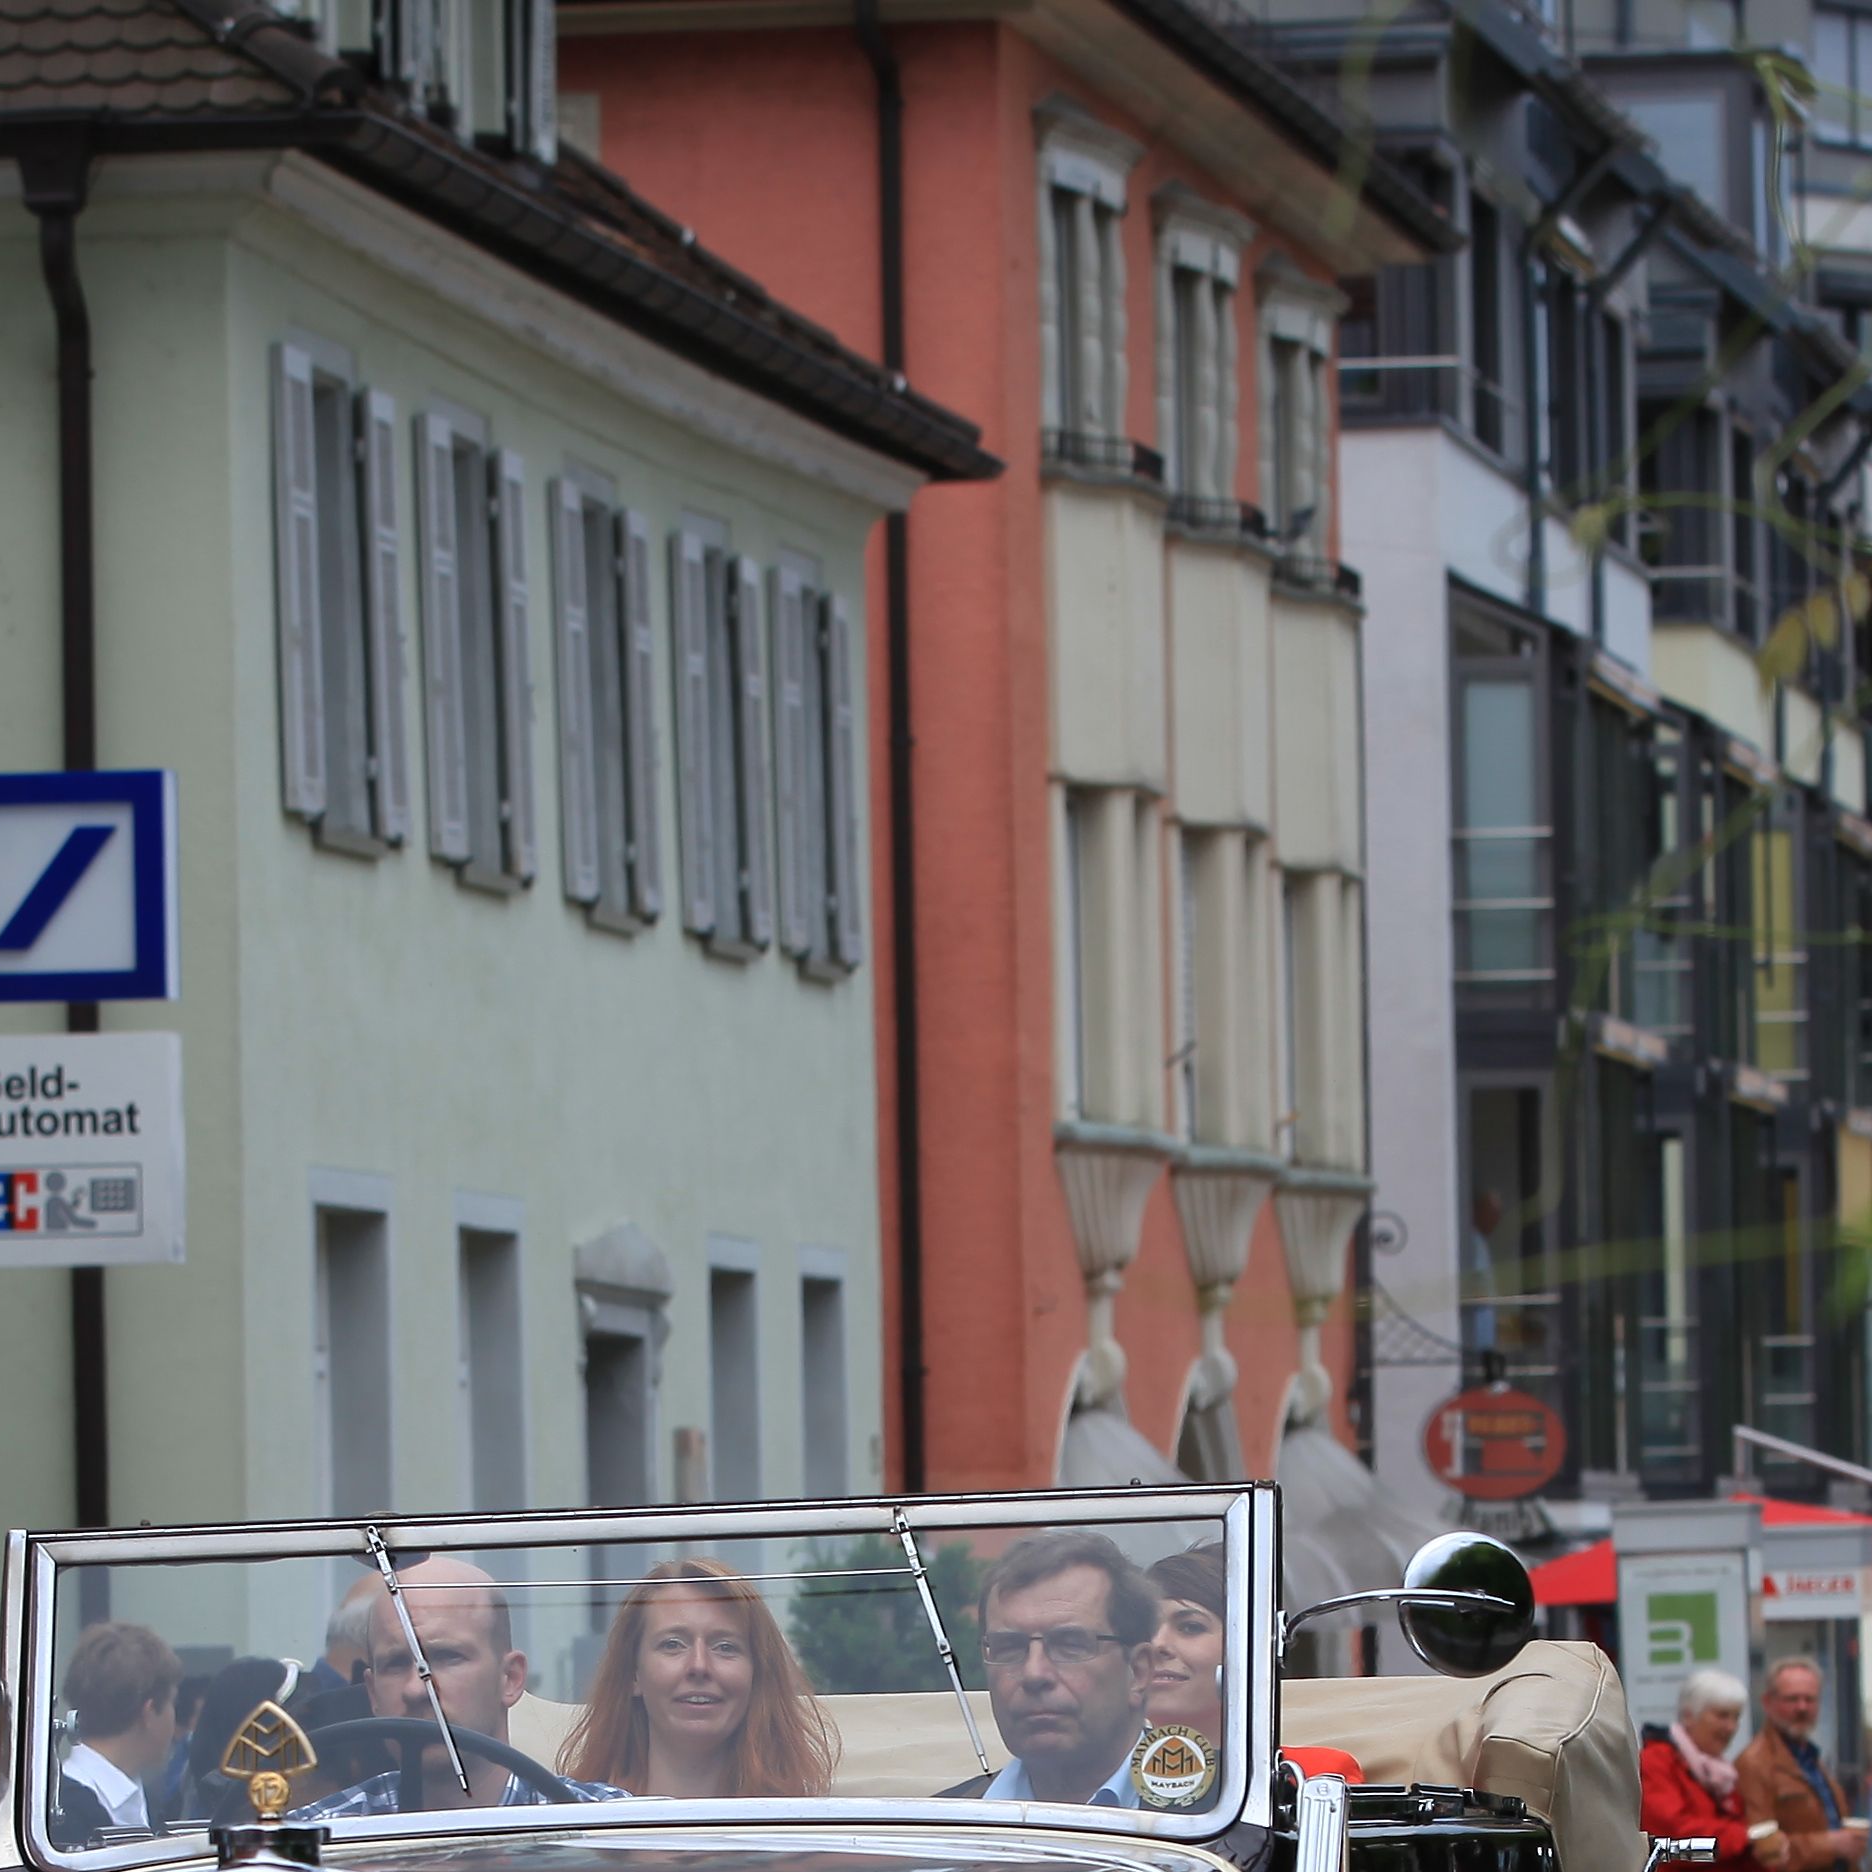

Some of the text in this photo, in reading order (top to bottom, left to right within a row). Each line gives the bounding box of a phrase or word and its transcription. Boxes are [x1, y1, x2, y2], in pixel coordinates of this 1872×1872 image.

[1132, 1726, 1216, 1768] MAYBACH CLUB
[1151, 1780, 1195, 1789] MAYBACH
